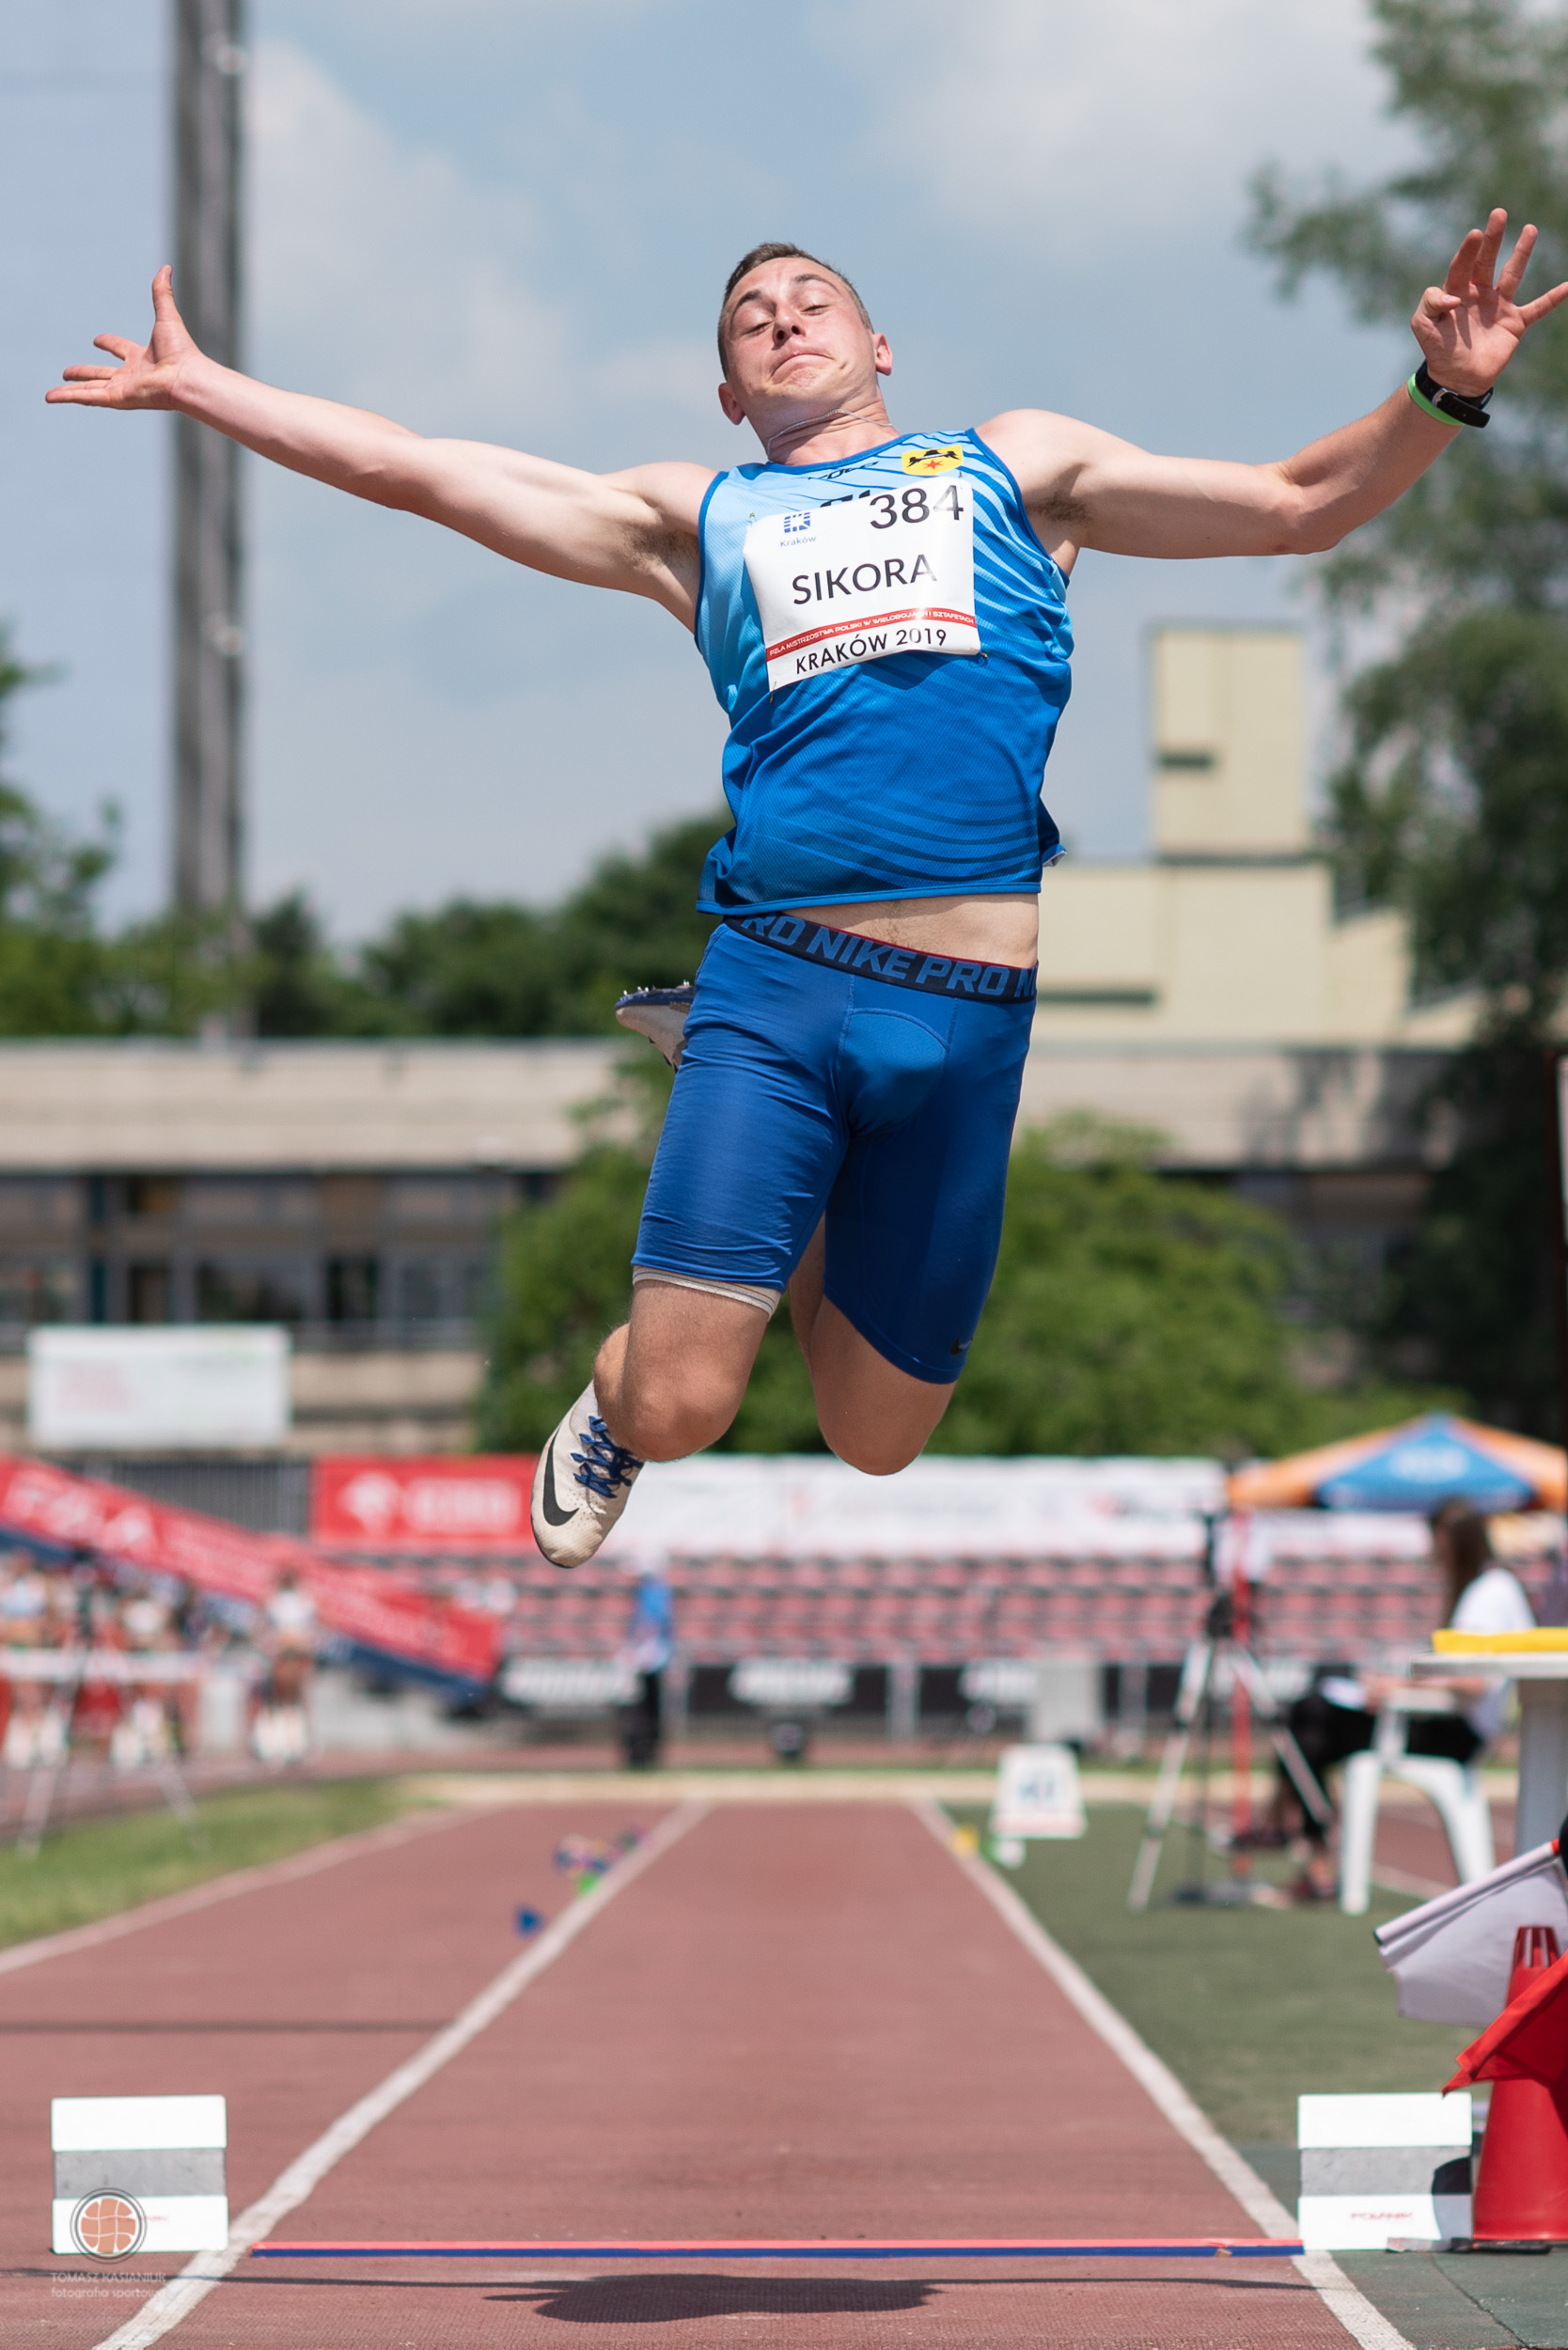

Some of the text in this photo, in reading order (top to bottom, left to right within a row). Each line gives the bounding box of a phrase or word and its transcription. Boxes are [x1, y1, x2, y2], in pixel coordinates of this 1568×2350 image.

[869, 484, 964, 529] 384
[779, 535, 817, 547] Kraków
[792, 554, 937, 604] SIKORA
[769, 646, 786, 656] PZLA
[786, 629, 835, 650] MISTRZOSTWA
[835, 621, 863, 633] POLSKI
[872, 610, 928, 624] WIELOBOJAH
[933, 611, 975, 624] SZTAFETACH
[795, 628, 947, 675] KRAKÓW 2019
[806, 926, 917, 980] NIKE
[916, 955, 1011, 996] PRO
